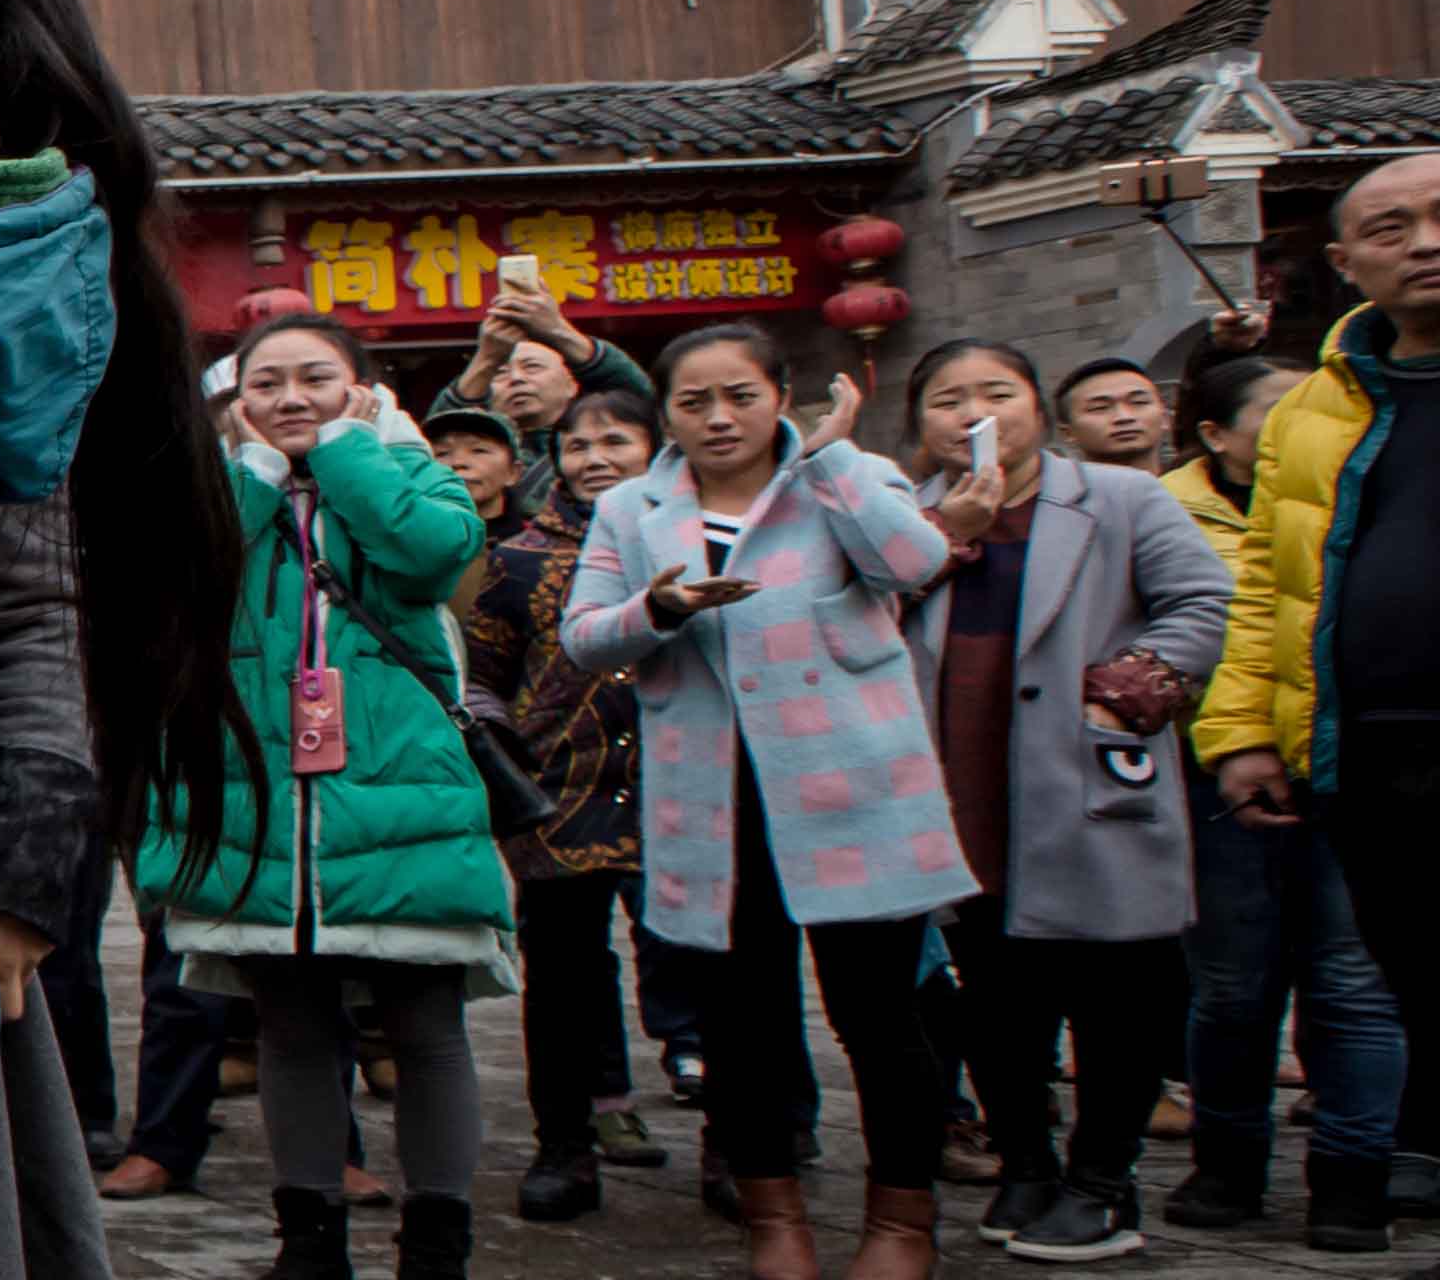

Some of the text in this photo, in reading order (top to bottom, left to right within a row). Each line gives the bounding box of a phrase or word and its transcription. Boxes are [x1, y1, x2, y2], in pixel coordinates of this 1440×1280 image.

[302, 210, 600, 314] 简朴寨
[606, 256, 798, 301] 设计师设计
